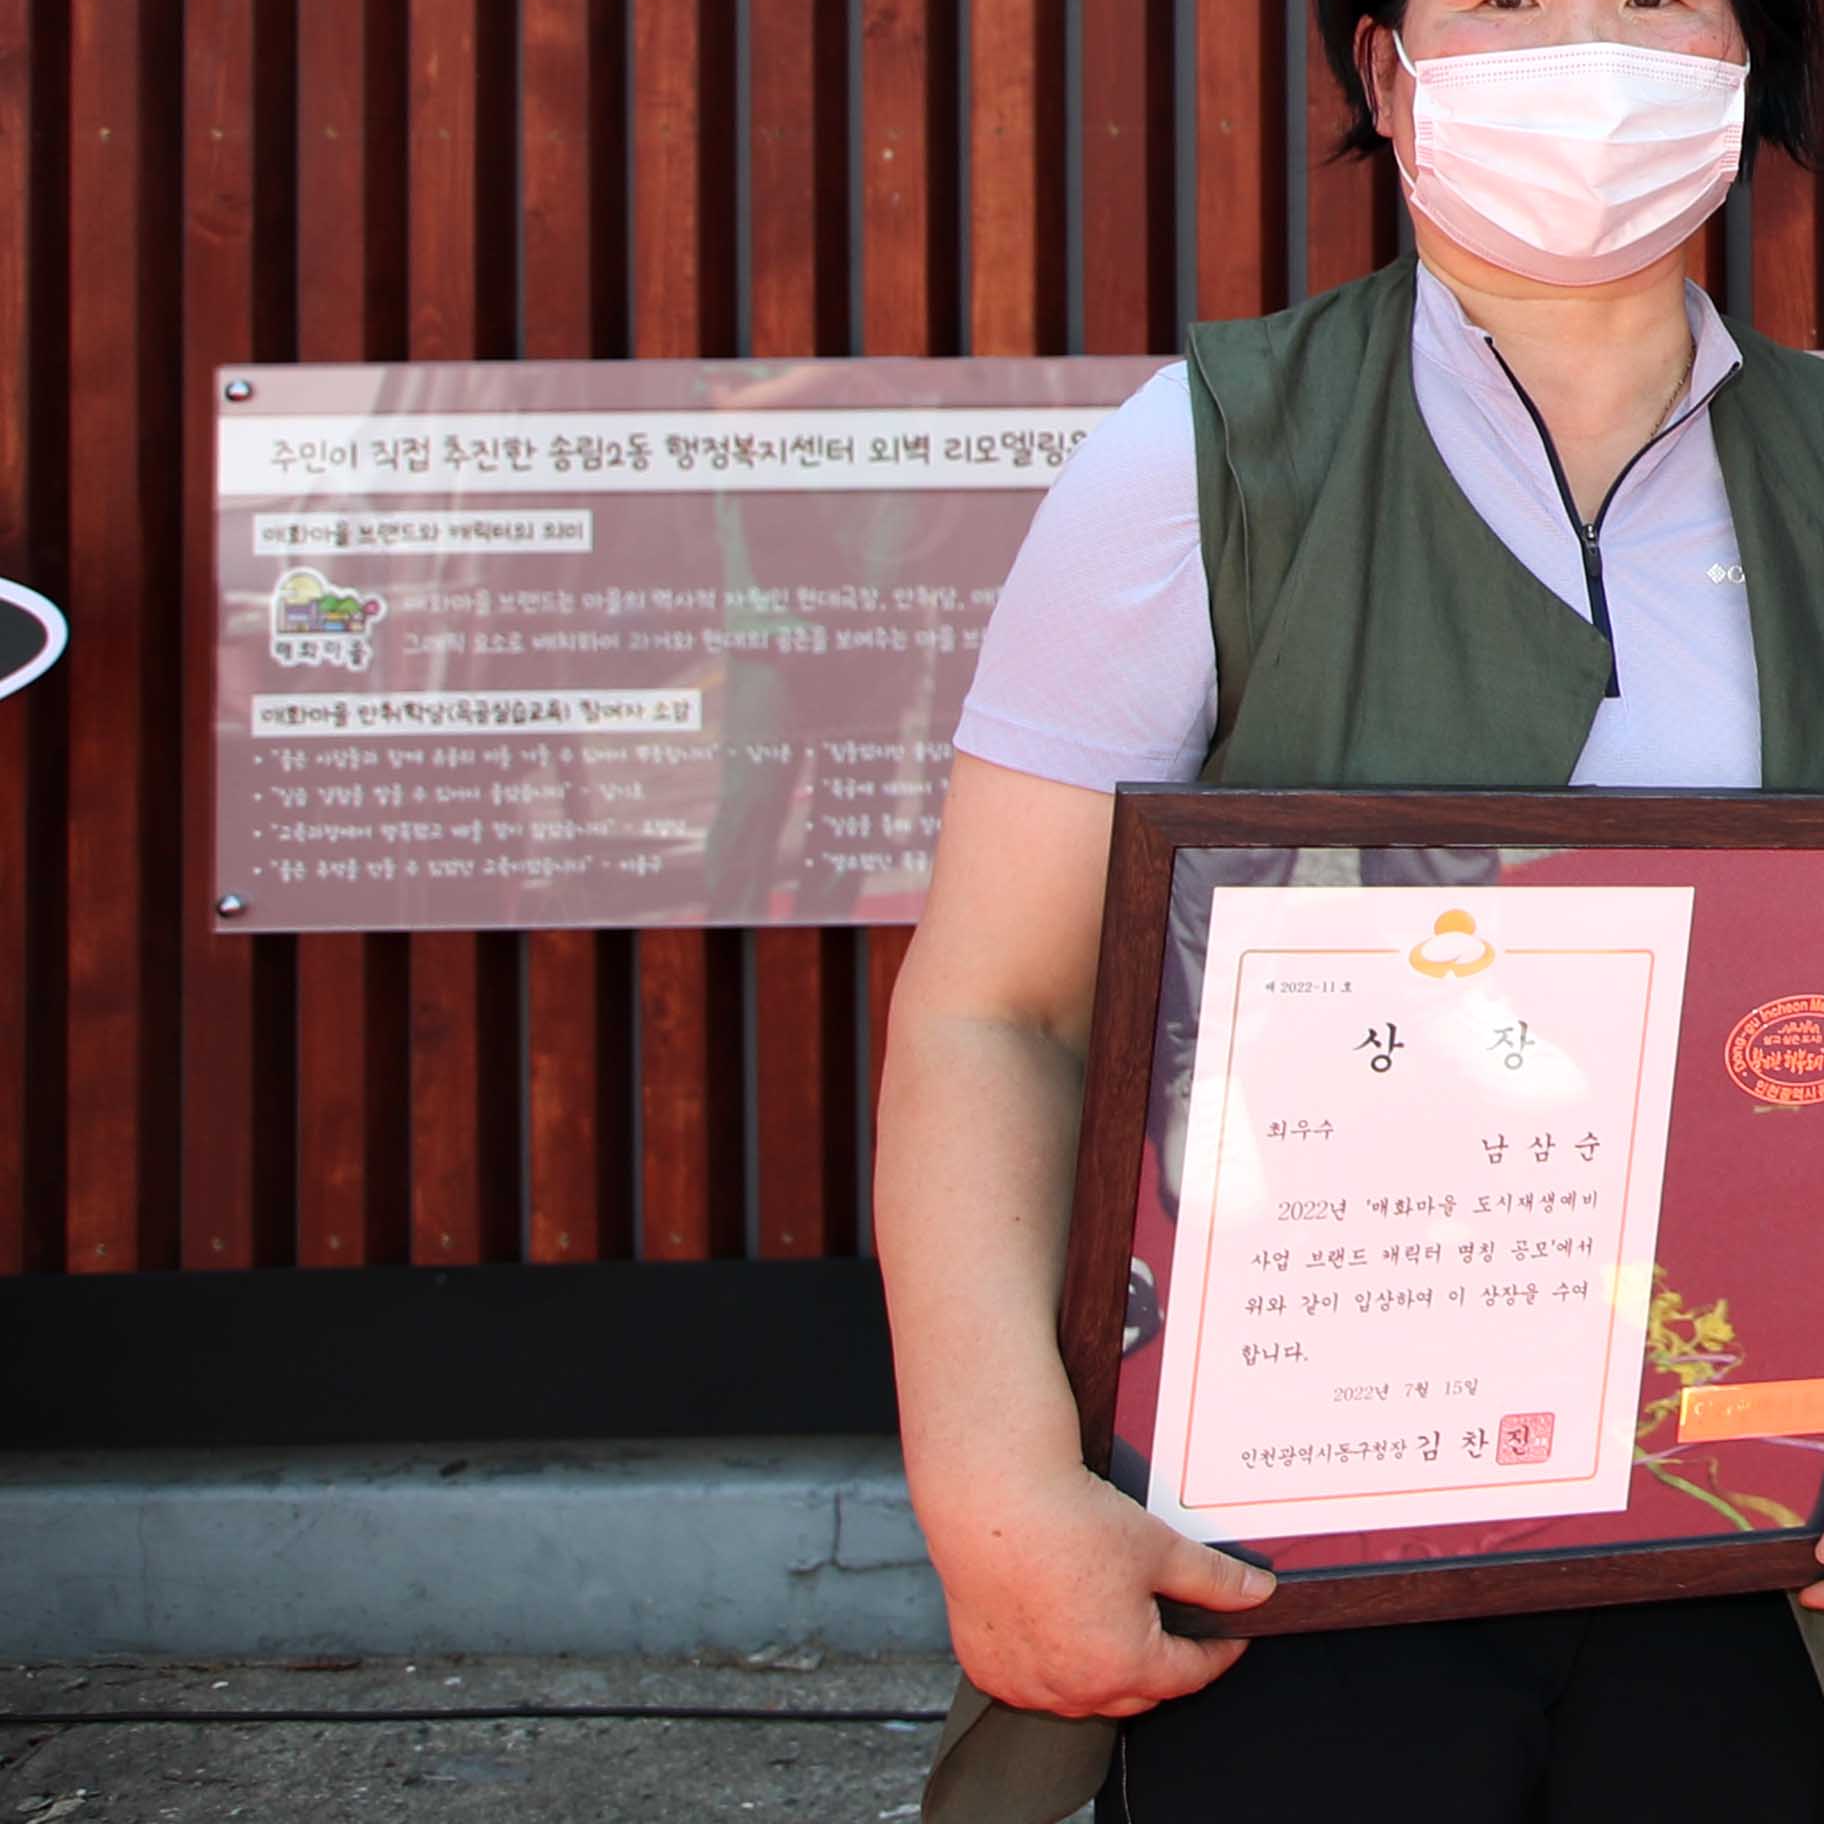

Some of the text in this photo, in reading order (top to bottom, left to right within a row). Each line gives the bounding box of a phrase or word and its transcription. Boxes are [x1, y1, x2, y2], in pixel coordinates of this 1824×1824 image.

[271, 437, 358, 473] 주민이
[371, 435, 430, 473] 직접
[444, 433, 536, 473] 추진한
[548, 432, 653, 473] 송림2동
[664, 432, 855, 469] 행정복지센터
[868, 434, 932, 466] 외벽
[1759, 1000, 1808, 1022] Incheon
[1267, 1119, 1334, 1141] 최우수
[1277, 1189, 1598, 1222] 2022년 '매화마을 도시재생예비
[1250, 1236, 1593, 1272] 사업 브랜드 캐릭터 명칭 공모'에서
[1245, 1280, 1589, 1316] 위와 같이 입상하여 이 상장을 수여
[1242, 1341, 1309, 1367] 합니다.
[1333, 1378, 1479, 1403] 2022년 7월 15일
[1241, 1438, 1407, 1469] 인천광역시동구청장
